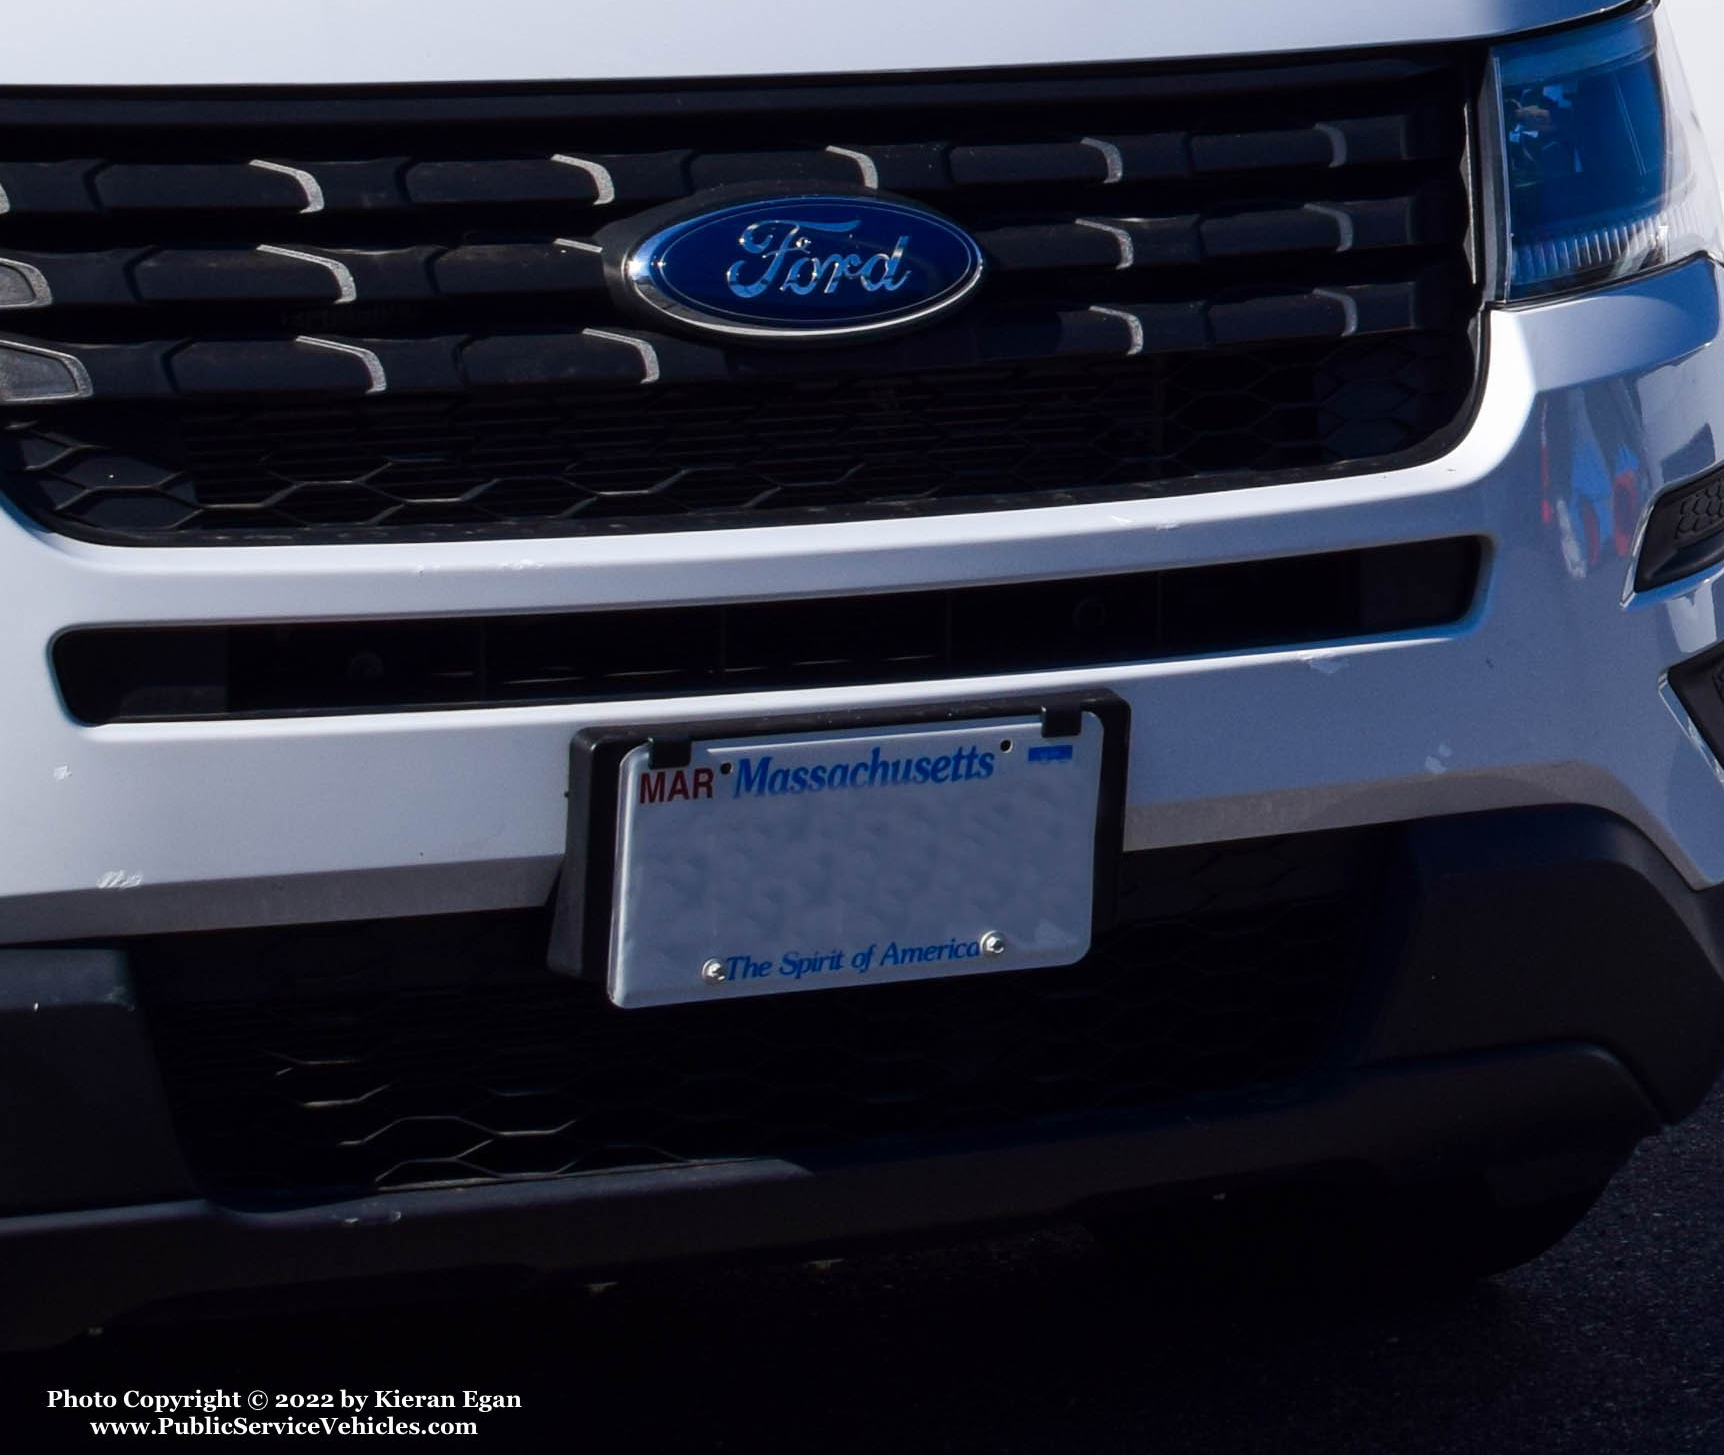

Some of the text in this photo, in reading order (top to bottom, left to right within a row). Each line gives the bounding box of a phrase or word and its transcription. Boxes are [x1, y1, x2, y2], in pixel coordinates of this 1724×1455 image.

[726, 219, 912, 299] Ford
[639, 767, 714, 804] MAR
[733, 746, 994, 798] Massachusetts
[727, 938, 981, 981] The Spirit of America
